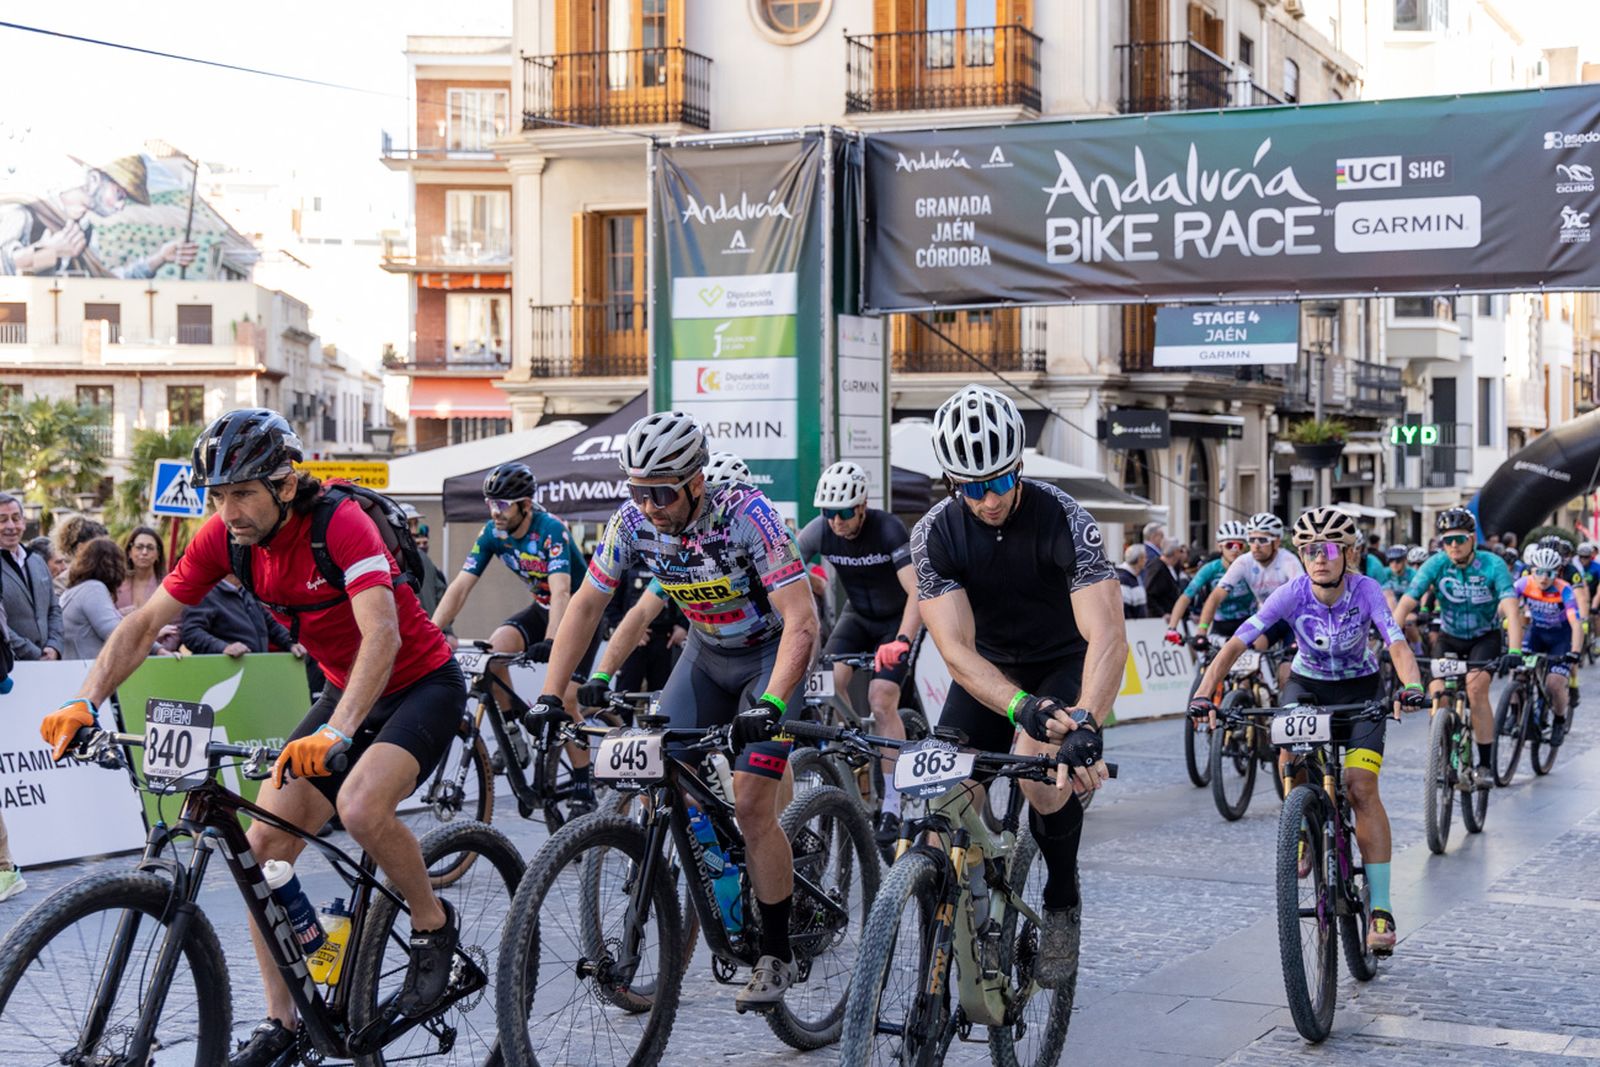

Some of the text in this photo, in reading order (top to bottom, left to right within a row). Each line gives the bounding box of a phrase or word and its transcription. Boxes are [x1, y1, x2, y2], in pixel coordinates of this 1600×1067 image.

[895, 150, 971, 173] Andalucía
[1348, 160, 1445, 183] UCI SHC
[1042, 137, 1320, 215] Andalucía
[683, 190, 792, 225] Andalucía
[915, 195, 992, 218] GRANADA
[932, 218, 975, 243] JAÉN
[1046, 213, 1159, 264] BIKE
[1174, 206, 1322, 259] RACE
[1352, 214, 1465, 236] GARMIN
[915, 244, 992, 268] CÓRDOBA
[726, 290, 772, 301] Diputación
[738, 298, 774, 308] Granada
[1192, 310, 1260, 326] STAGE 4
[1204, 326, 1248, 342] JAÉN
[1199, 350, 1250, 361] GARMIN
[725, 371, 770, 382] Diputación
[703, 421, 783, 439] ARMIN
[804, 674, 824, 692] 61
[153, 706, 192, 725] OPEN
[1285, 716, 1317, 737] 879
[147, 727, 192, 769] 840
[610, 740, 648, 770] 845
[912, 750, 957, 777] 863
[0, 780, 47, 809] AÉN
